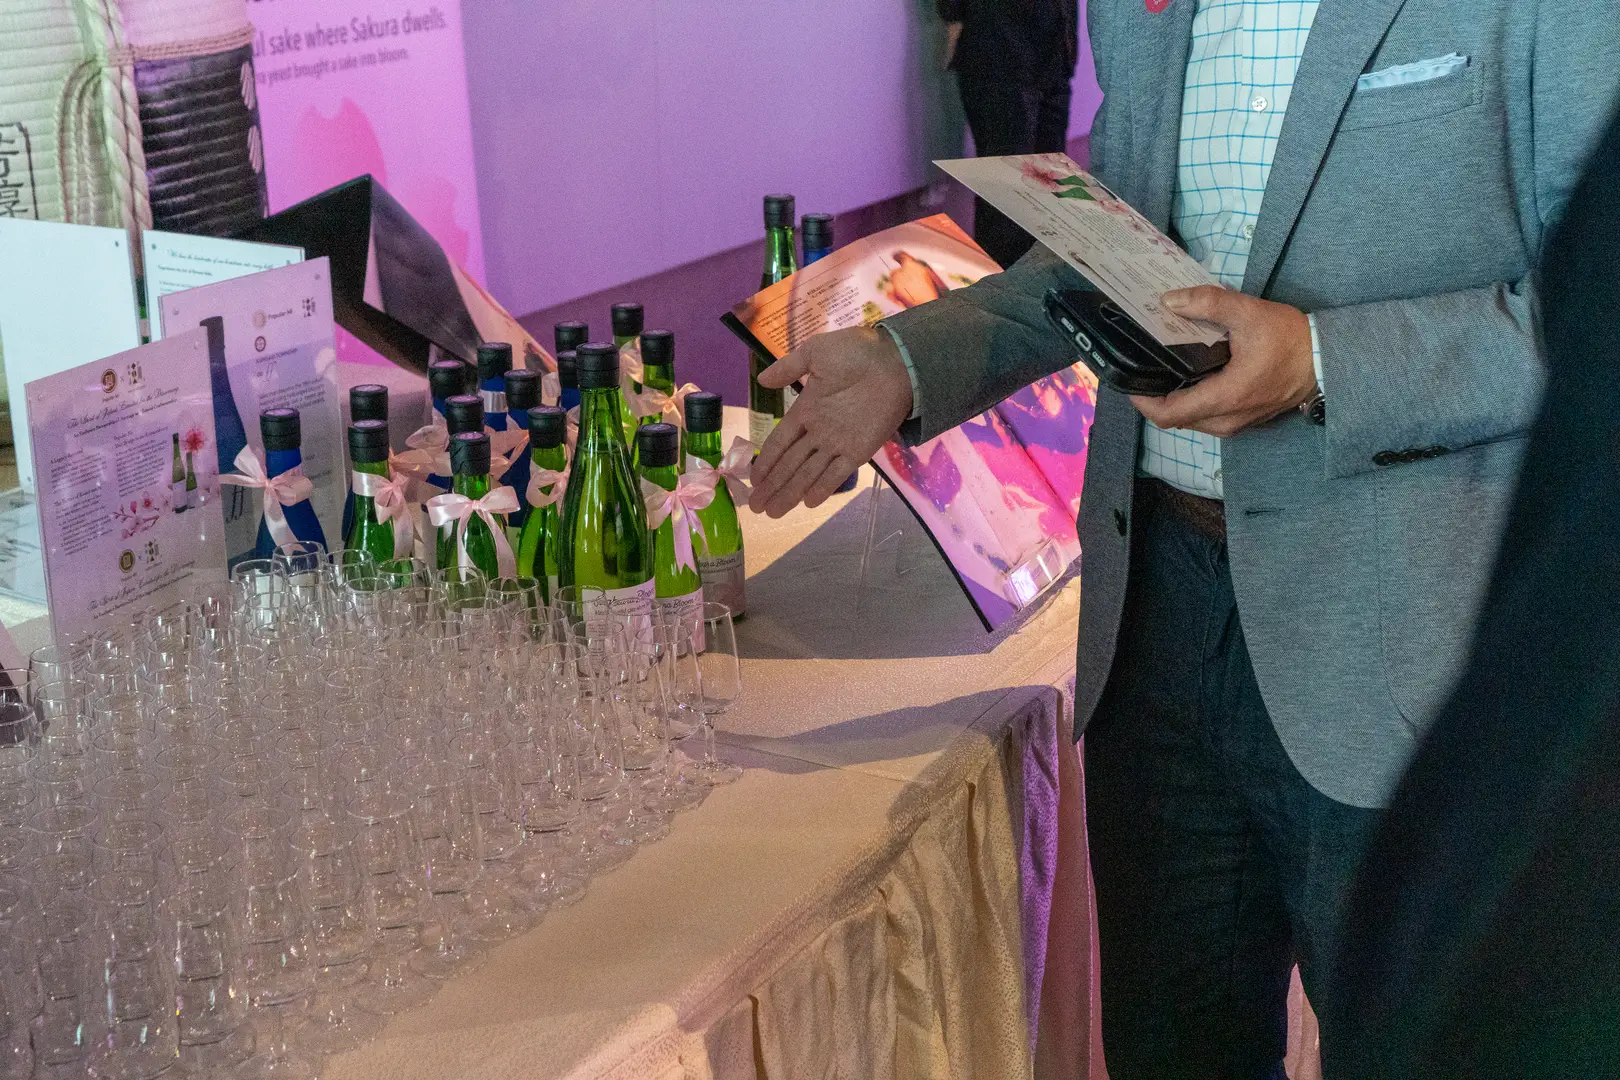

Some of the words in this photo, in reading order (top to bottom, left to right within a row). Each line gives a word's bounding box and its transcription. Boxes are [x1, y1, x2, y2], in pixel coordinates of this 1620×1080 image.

[269, 28, 301, 55] sake
[304, 22, 349, 49] where
[351, 15, 399, 43] Sakura
[670, 598, 694, 609] Bloom
